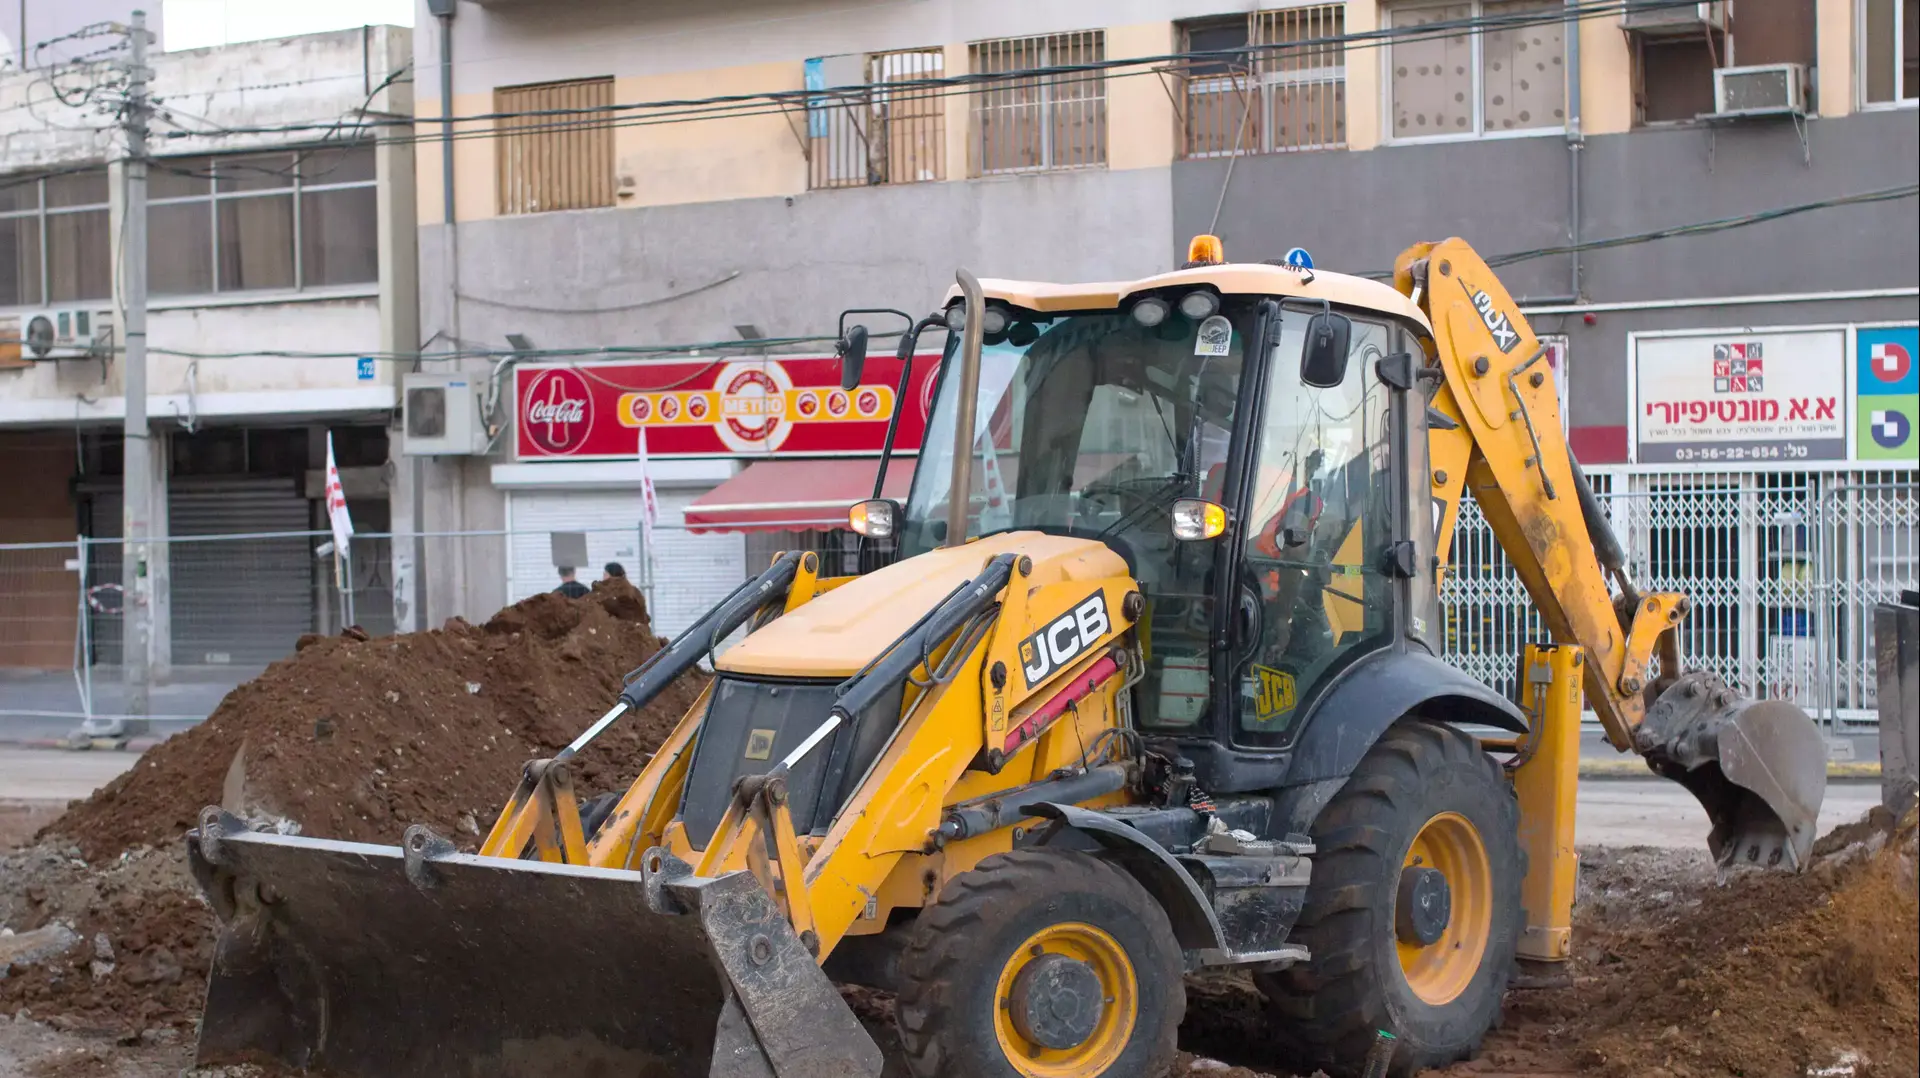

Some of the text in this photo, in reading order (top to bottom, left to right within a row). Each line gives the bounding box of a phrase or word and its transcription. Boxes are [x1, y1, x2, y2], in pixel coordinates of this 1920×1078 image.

[1473, 290, 1516, 349] 3CX
[724, 398, 782, 414] METRO
[1646, 399, 1780, 425] מונטיפיורי
[1675, 446, 1779, 460] 03-56-22-654
[1026, 596, 1108, 683] JCB
[1259, 669, 1294, 715] JCB
